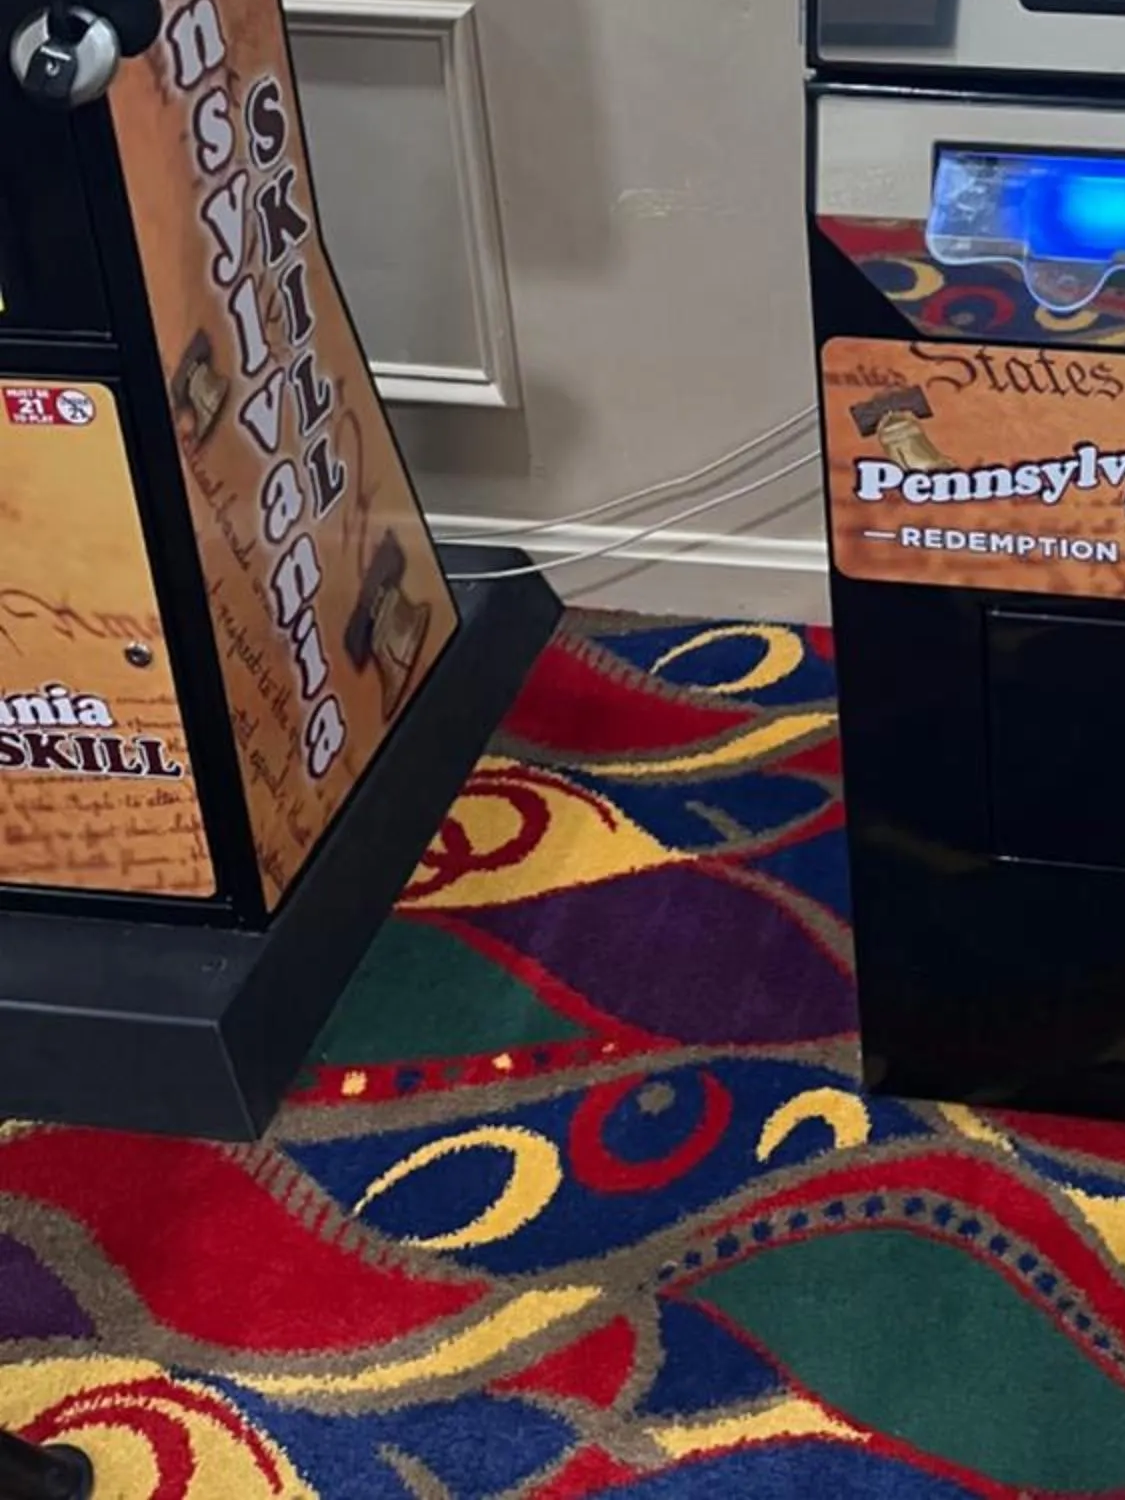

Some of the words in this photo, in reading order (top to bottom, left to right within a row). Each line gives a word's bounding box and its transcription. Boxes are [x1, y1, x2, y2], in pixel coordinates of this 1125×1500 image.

[244, 76, 348, 519] SKILL
[17, 398, 44, 415] 21
[901, 527, 1117, 562] REDEMPTION
[0, 732, 183, 779] SKILL
